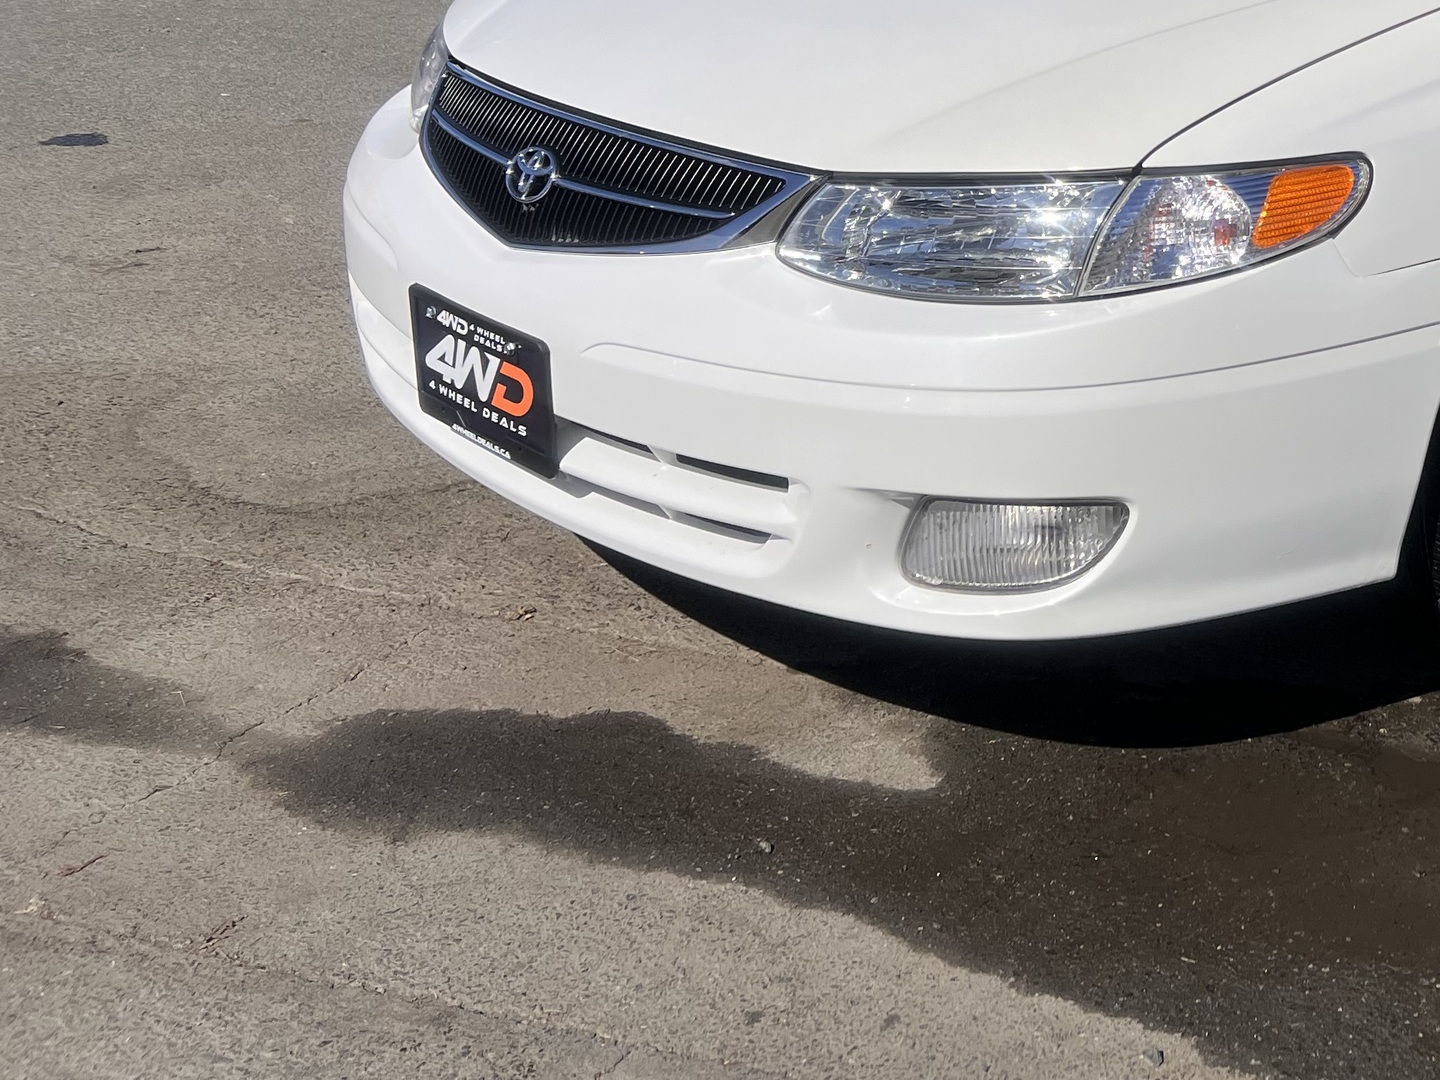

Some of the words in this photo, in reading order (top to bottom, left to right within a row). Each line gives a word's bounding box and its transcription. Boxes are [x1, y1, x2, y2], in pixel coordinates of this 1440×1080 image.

[437, 310, 468, 335] 4WD
[476, 326, 505, 344] WHEEL
[473, 334, 502, 352] DEALS
[425, 334, 534, 417] 4WD
[429, 380, 436, 389] 4
[439, 384, 478, 412] WHEEL
[482, 408, 527, 436] DEALS
